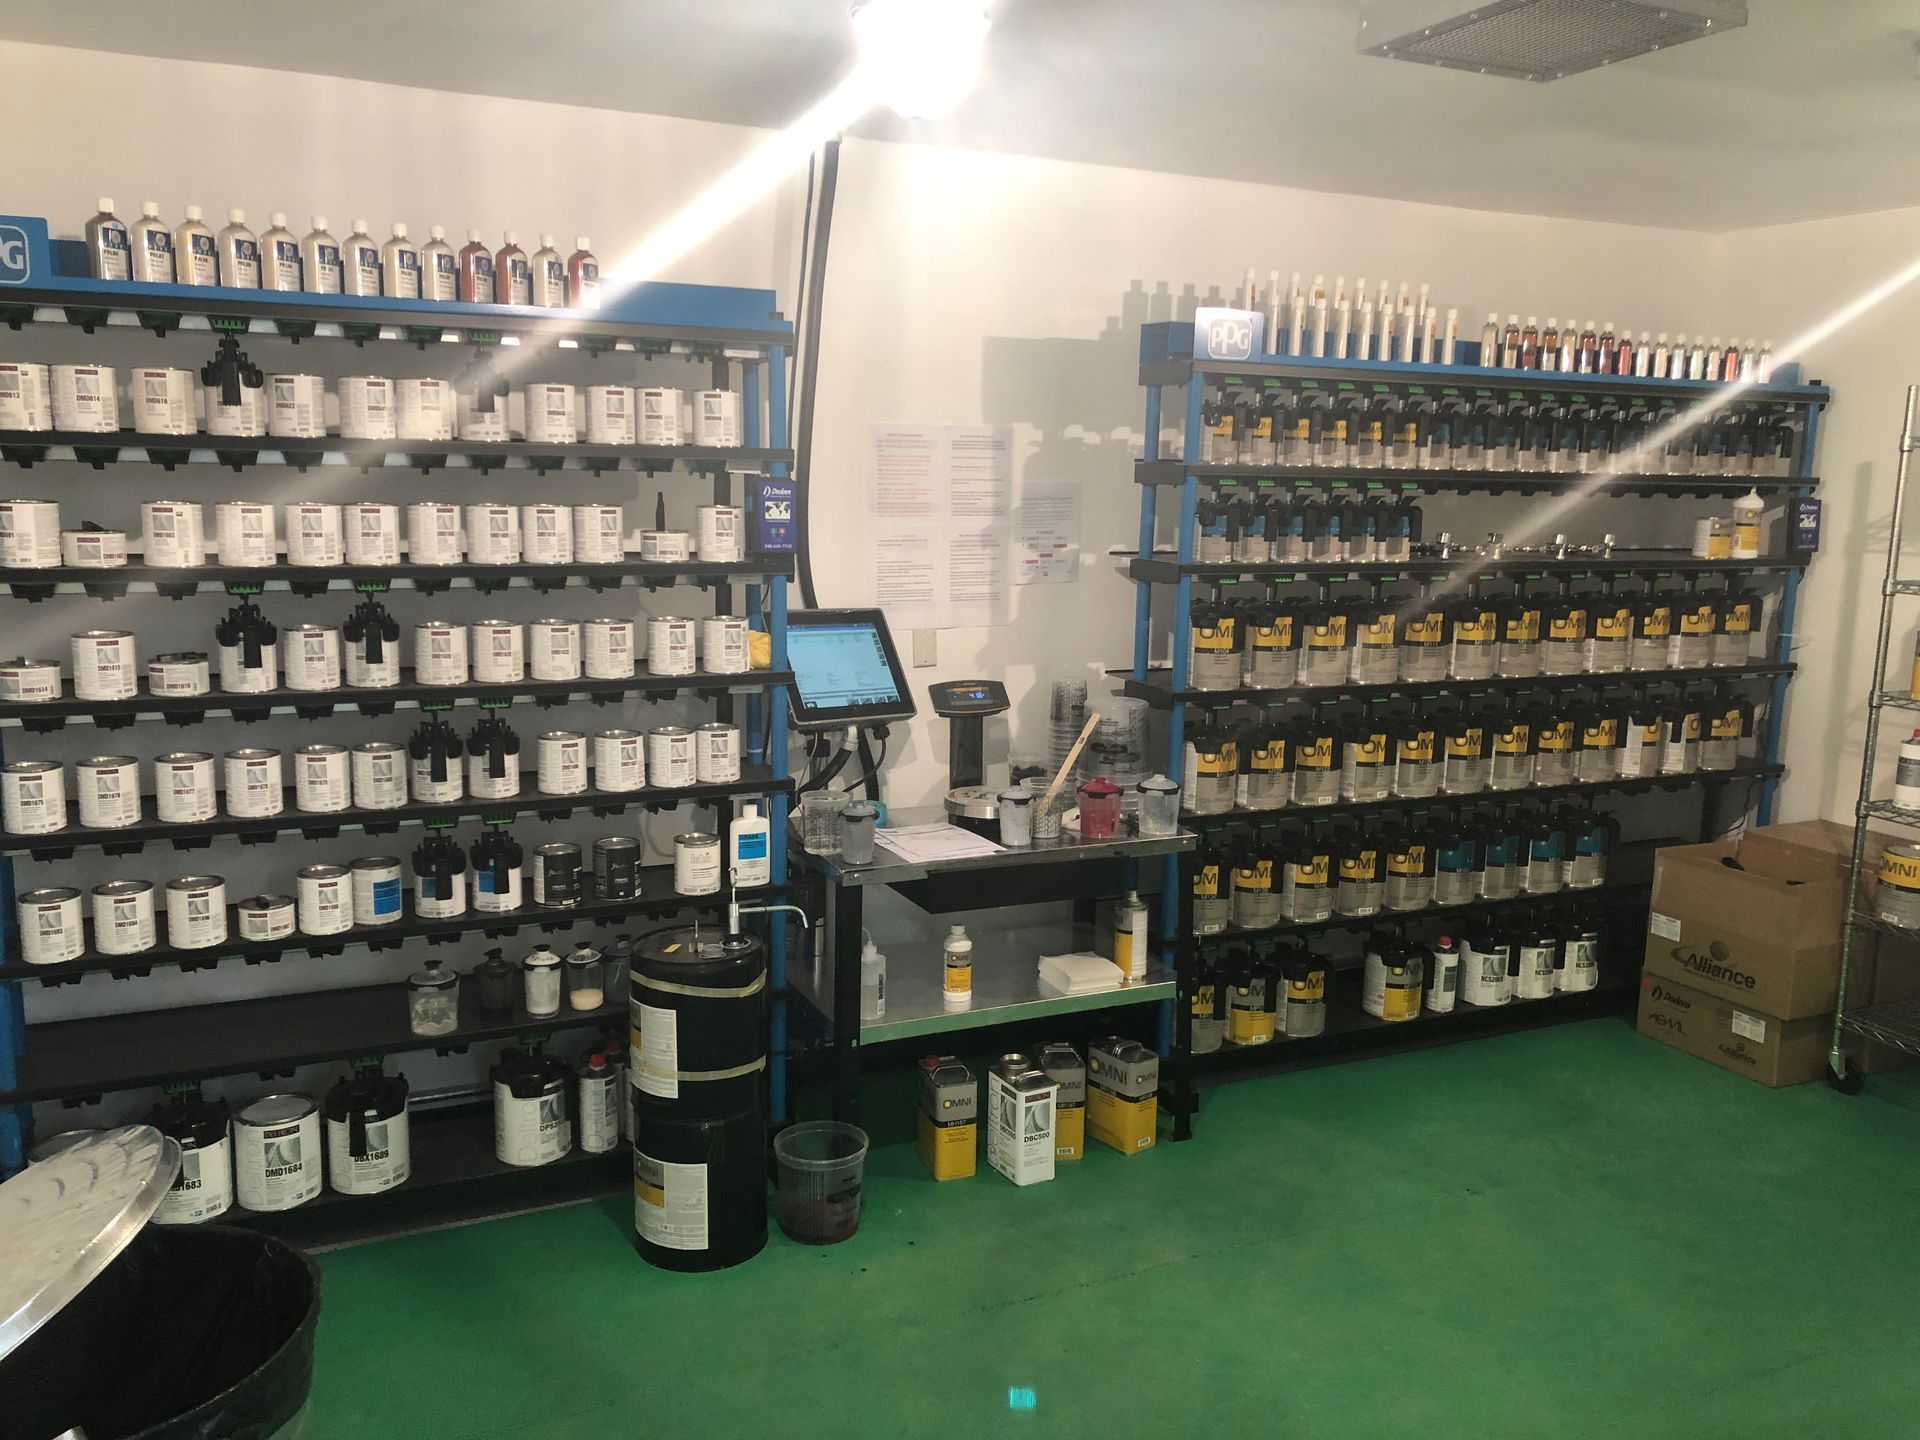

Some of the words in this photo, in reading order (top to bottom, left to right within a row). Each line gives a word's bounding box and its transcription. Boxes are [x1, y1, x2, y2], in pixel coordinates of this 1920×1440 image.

[1210, 321, 1249, 355] PPG
[0, 391, 20, 399] MD613
[1199, 626, 1232, 639] OM
[1257, 624, 1290, 638] OM
[1314, 624, 1345, 637] OM
[1368, 621, 1393, 634] OM
[1409, 620, 1441, 634] OM
[1501, 731, 1527, 744] OM
[1586, 726, 1613, 738] OM
[1362, 740, 1385, 754] OM
[1405, 738, 1433, 751] OM
[1453, 734, 1480, 747] OM
[1254, 747, 1283, 760] OM
[1302, 744, 1331, 758] OM
[1342, 857, 1374, 870] OM
[1393, 852, 1424, 865] OM
[1239, 867, 1272, 880] OM
[1301, 862, 1328, 876] OM
[1686, 953, 1756, 990] Alliance
[1292, 976, 1324, 991] OM
[1236, 984, 1264, 997] OM
[1089, 1056, 1128, 1086] OMNI
[943, 1097, 972, 1109] OMNI
[1024, 1131, 1050, 1143] DBC500
[265, 1162, 303, 1178] DMD1684
